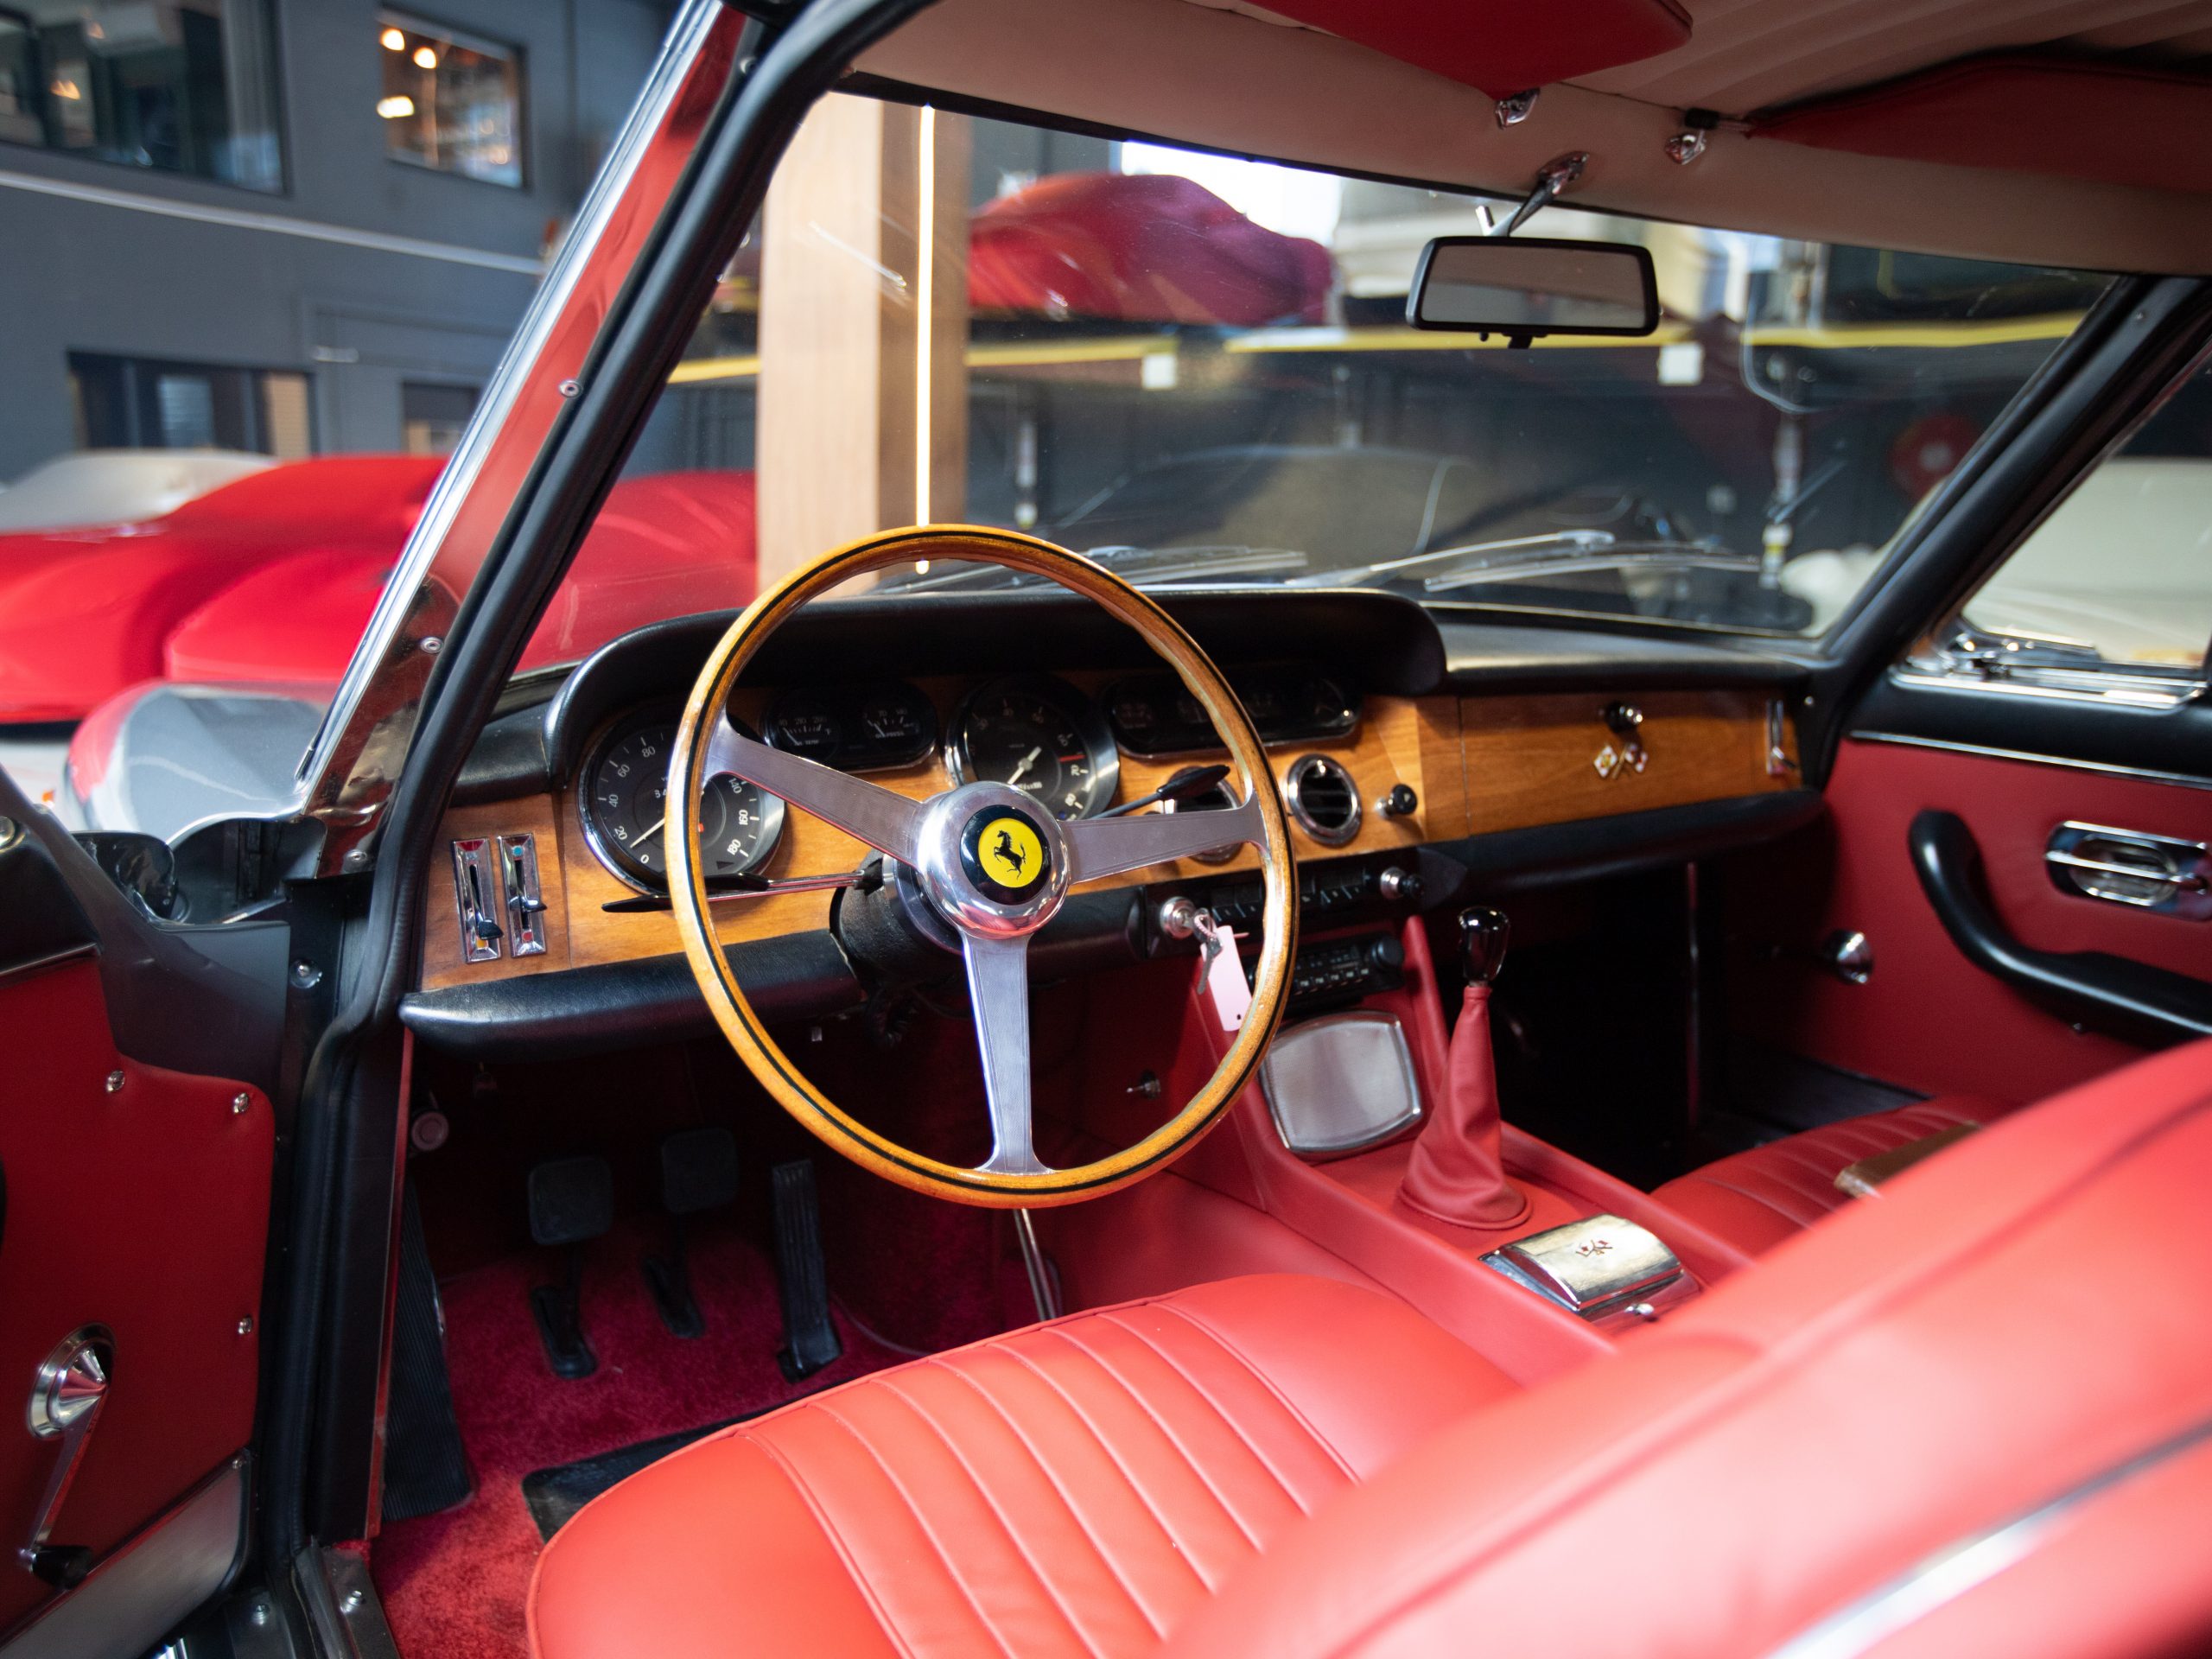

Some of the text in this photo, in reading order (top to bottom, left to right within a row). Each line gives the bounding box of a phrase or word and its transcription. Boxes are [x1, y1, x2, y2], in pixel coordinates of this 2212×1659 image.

[642, 746, 655, 758] 80
[617, 764, 630, 778] 60
[728, 778, 742, 794] 140
[608, 794, 619, 808] 40
[739, 809, 748, 825] 160
[614, 825, 627, 840] 20
[727, 838, 741, 855] 180
[640, 854, 650, 864] 0
